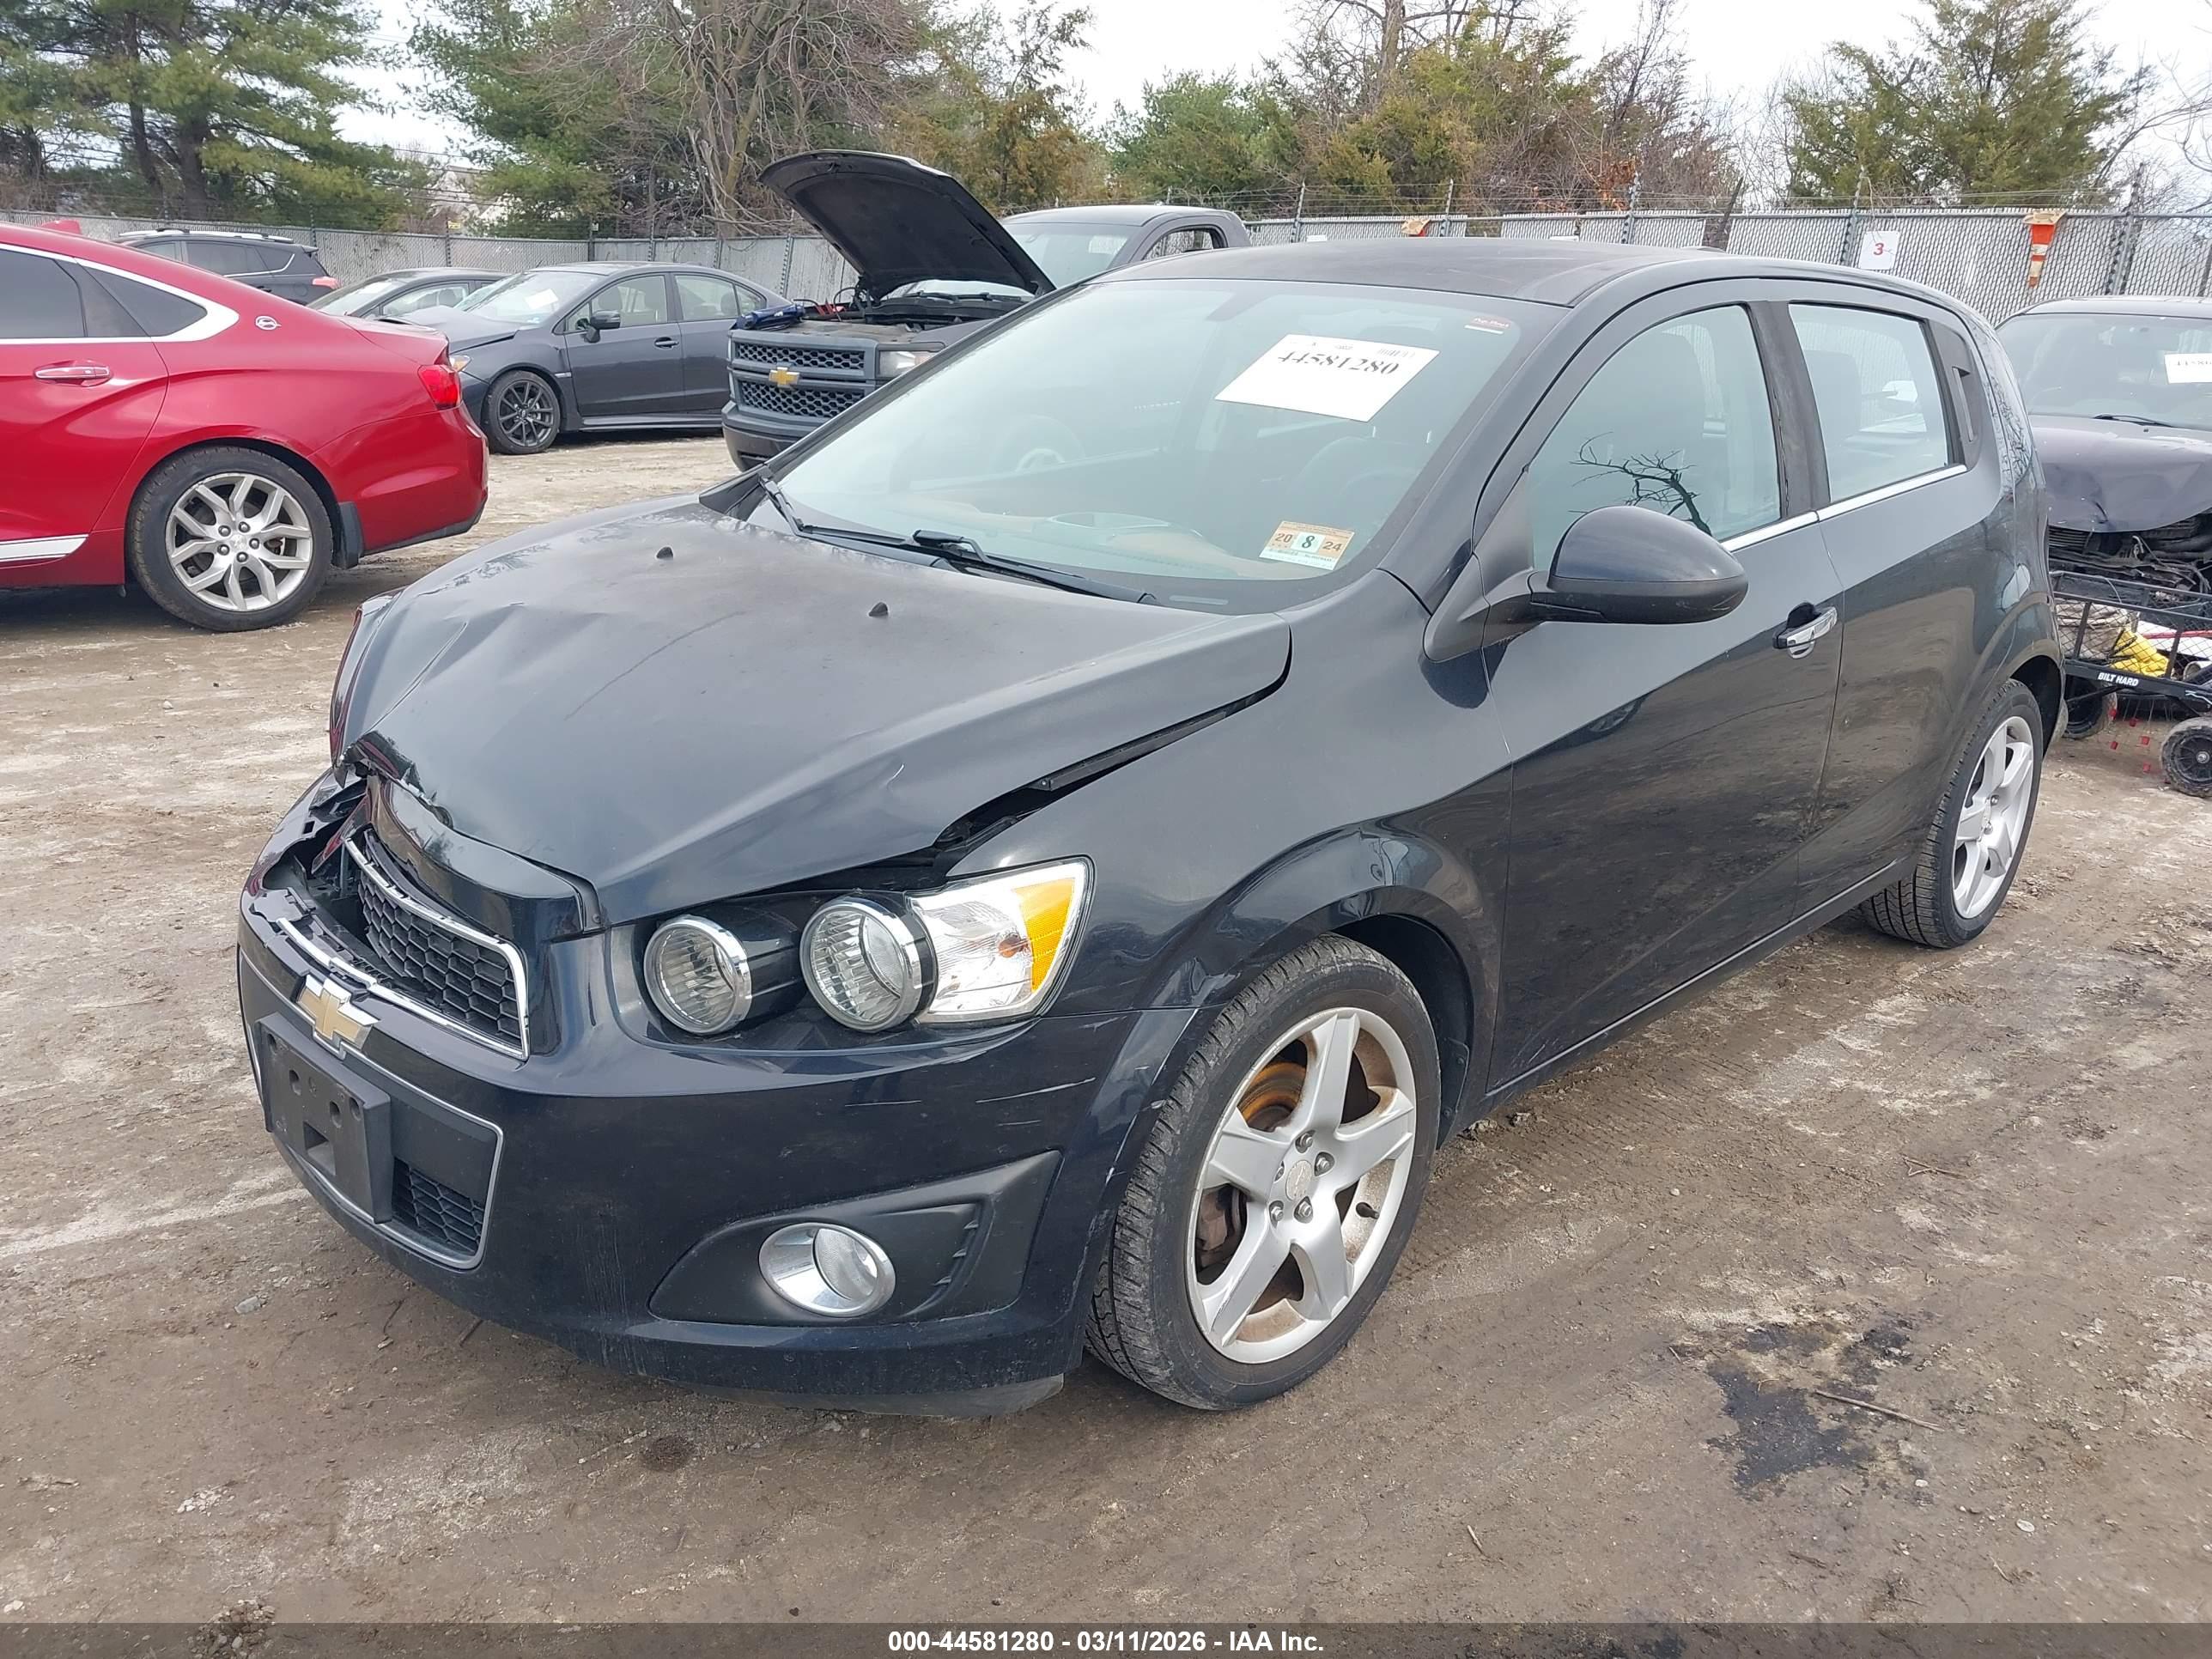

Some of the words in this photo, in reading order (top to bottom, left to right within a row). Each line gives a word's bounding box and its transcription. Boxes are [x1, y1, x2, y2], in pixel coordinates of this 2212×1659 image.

[1873, 242, 1885, 256] 3
[1278, 350, 1400, 375] 44581280
[1274, 532, 1294, 544] 20
[1301, 535, 1316, 549] 8
[1322, 541, 1343, 551] 24
[2097, 672, 2116, 683] BILT
[2116, 674, 2139, 687] HARD
